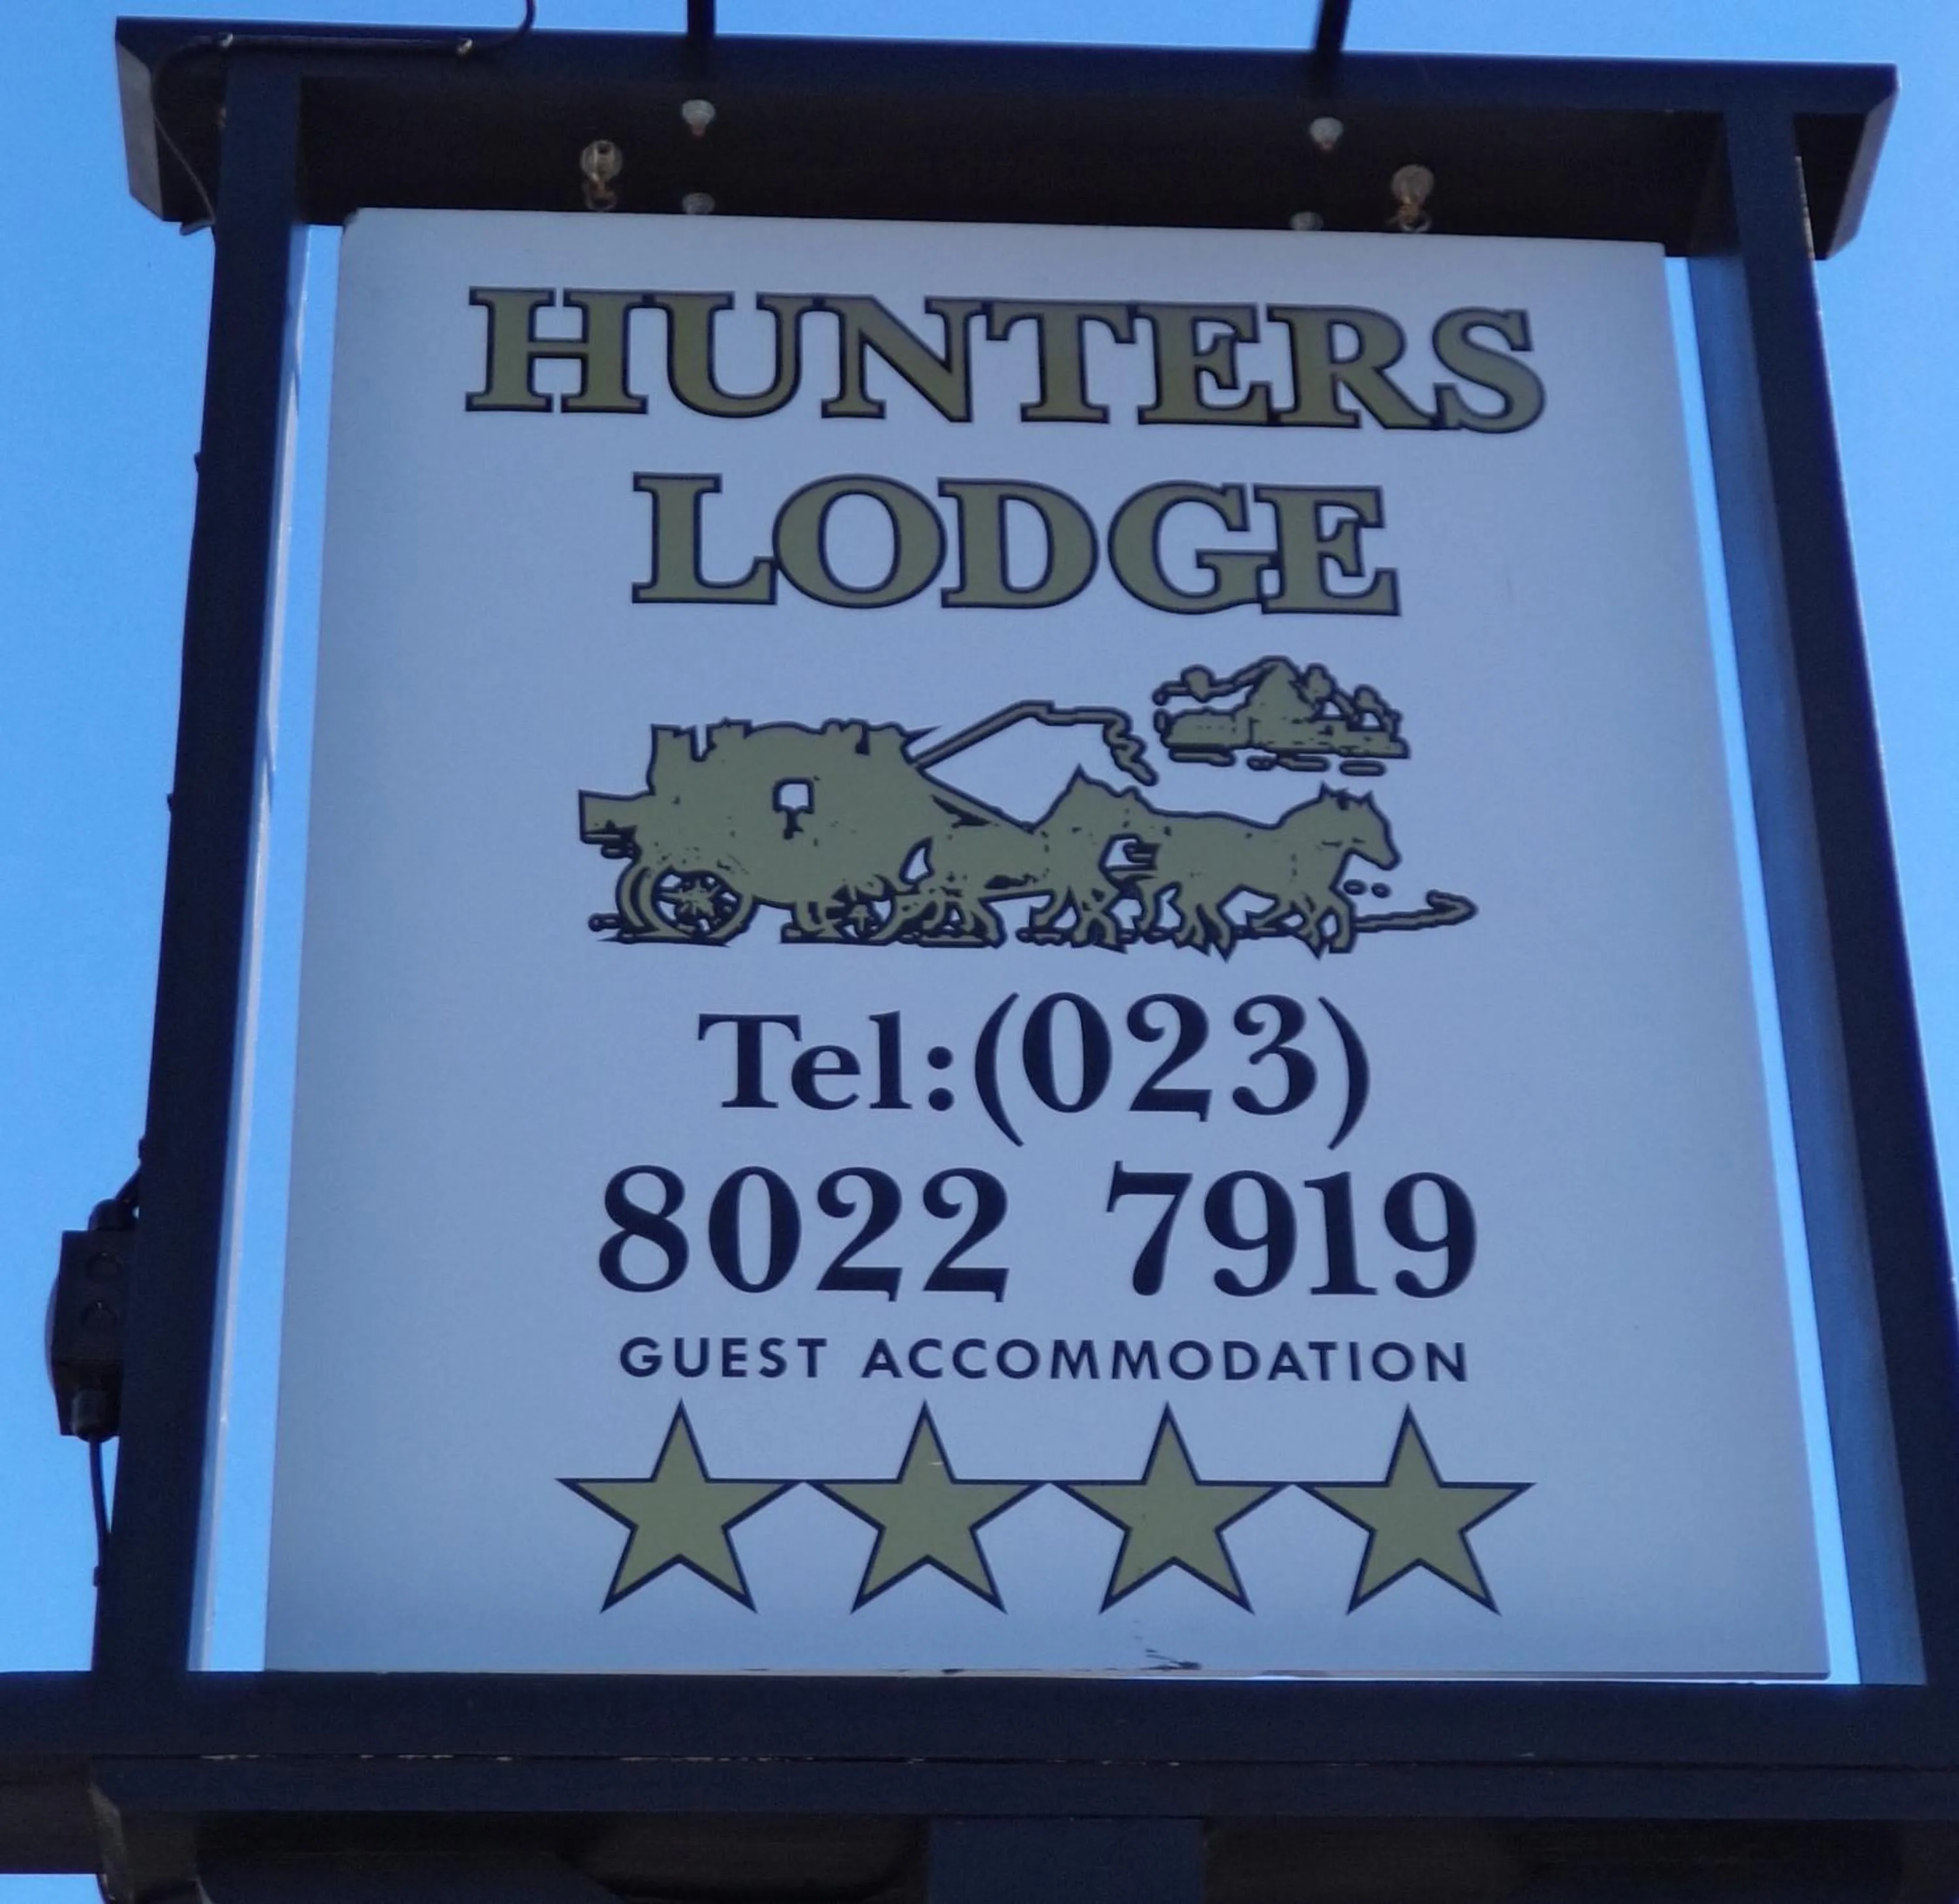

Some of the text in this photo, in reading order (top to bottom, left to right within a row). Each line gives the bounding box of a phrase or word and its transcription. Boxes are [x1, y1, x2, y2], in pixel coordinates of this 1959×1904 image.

[465, 287, 1546, 435] HUNTERS
[631, 471, 1401, 616] LODGE
[598, 1160, 1476, 1303] 8022 7919
[620, 1337, 1466, 1382] GUEST ACCOMMODATION
